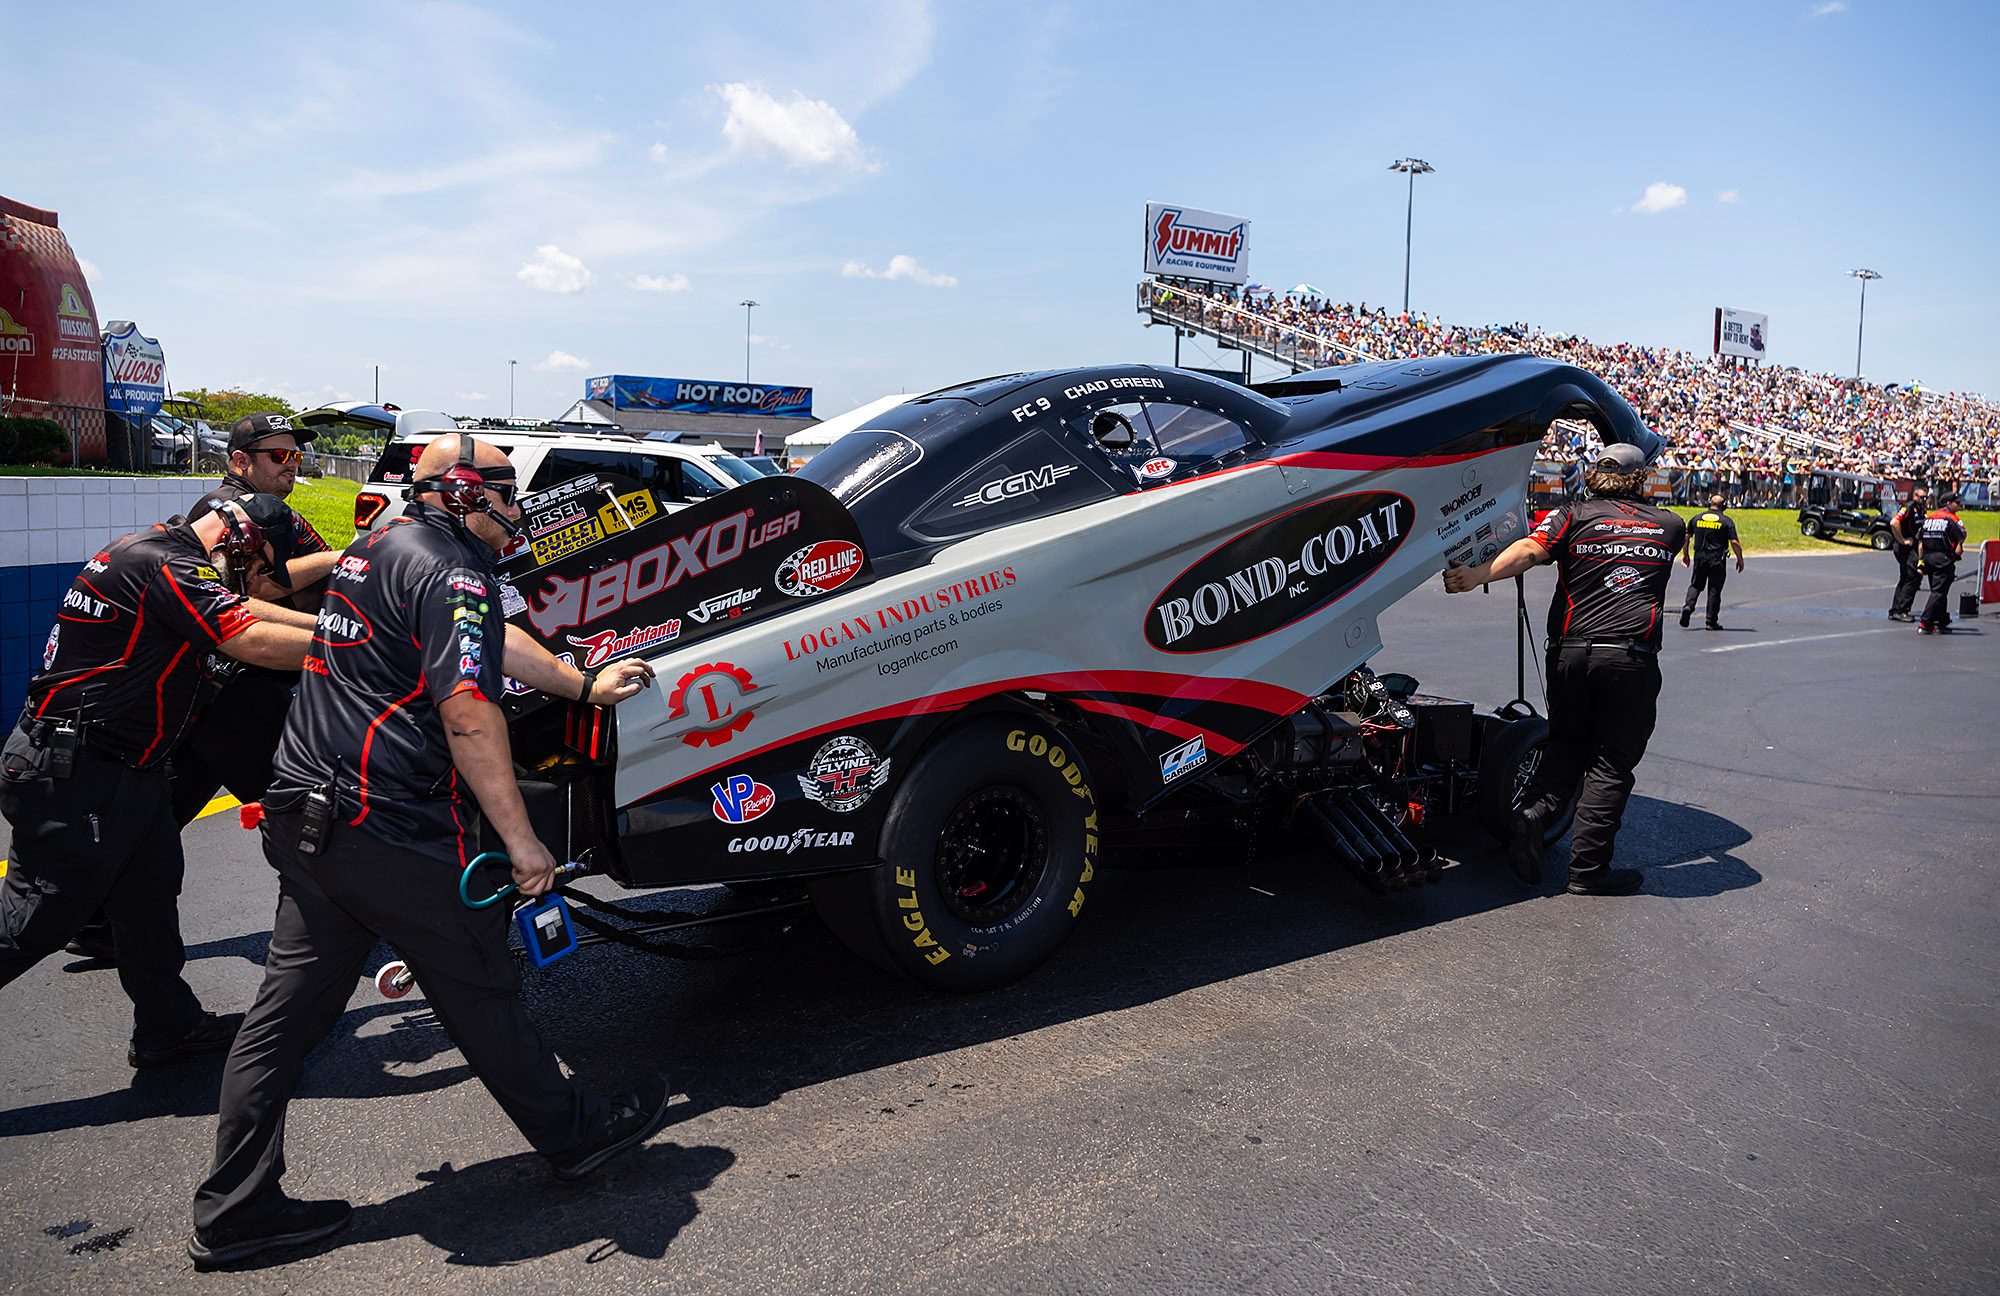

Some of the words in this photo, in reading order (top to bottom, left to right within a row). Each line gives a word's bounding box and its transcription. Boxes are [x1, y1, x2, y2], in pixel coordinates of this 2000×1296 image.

[1166, 258, 1193, 267] RACING
[1195, 262, 1235, 273] EQUIPMENT
[52, 348, 101, 362] #2FAST2TAST
[114, 359, 162, 384] LUCAS
[125, 389, 163, 403] PRODUCTS
[676, 383, 719, 400] HOT
[723, 387, 764, 404] ROD
[759, 388, 807, 411] Grill
[1012, 403, 1034, 422] FC
[1036, 397, 1051, 411] 9
[1064, 379, 1109, 400] CHAD
[1113, 376, 1165, 390] GREEN
[1145, 460, 1170, 474] RFC
[522, 474, 599, 509] QRS
[979, 463, 1057, 505] CGM
[525, 500, 557, 515] RACING
[606, 494, 649, 524] TMS
[1440, 483, 1483, 517] MONROE
[529, 501, 585, 532] JESEL
[613, 510, 650, 529] TITNIUM
[1696, 519, 1723, 529] SECURITY
[535, 518, 598, 558] BULLET
[545, 545, 575, 562] RACING
[576, 533, 599, 548] CAMS
[1449, 535, 1472, 554] WAGNER
[582, 511, 748, 625] BOXO
[748, 509, 801, 549] USA
[801, 558, 827, 581] RED
[811, 569, 841, 584] SYNTHETIC
[1157, 499, 1402, 645] BOND-COAT
[1288, 580, 1309, 599] INC.
[687, 587, 762, 624] Sander
[783, 614, 872, 662] LOGAN
[876, 566, 1017, 630] INDUSTRIES
[816, 630, 912, 673] Manufacturing
[913, 617, 947, 644] parts
[949, 612, 960, 626] &
[962, 599, 1003, 622] bodies
[877, 639, 958, 676] logankc.com
[1369, 682, 1383, 691] MSD
[699, 682, 733, 723] L
[1394, 709, 1410, 719] MSD
[816, 756, 871, 776] FLYING
[1164, 756, 1206, 782] CARRILLO
[711, 774, 755, 823] VP
[743, 793, 774, 816] Racing
[1006, 730, 1098, 918] GOODYEAR
[728, 830, 855, 854] GOODYEAR
[896, 866, 951, 966] EAGLE
